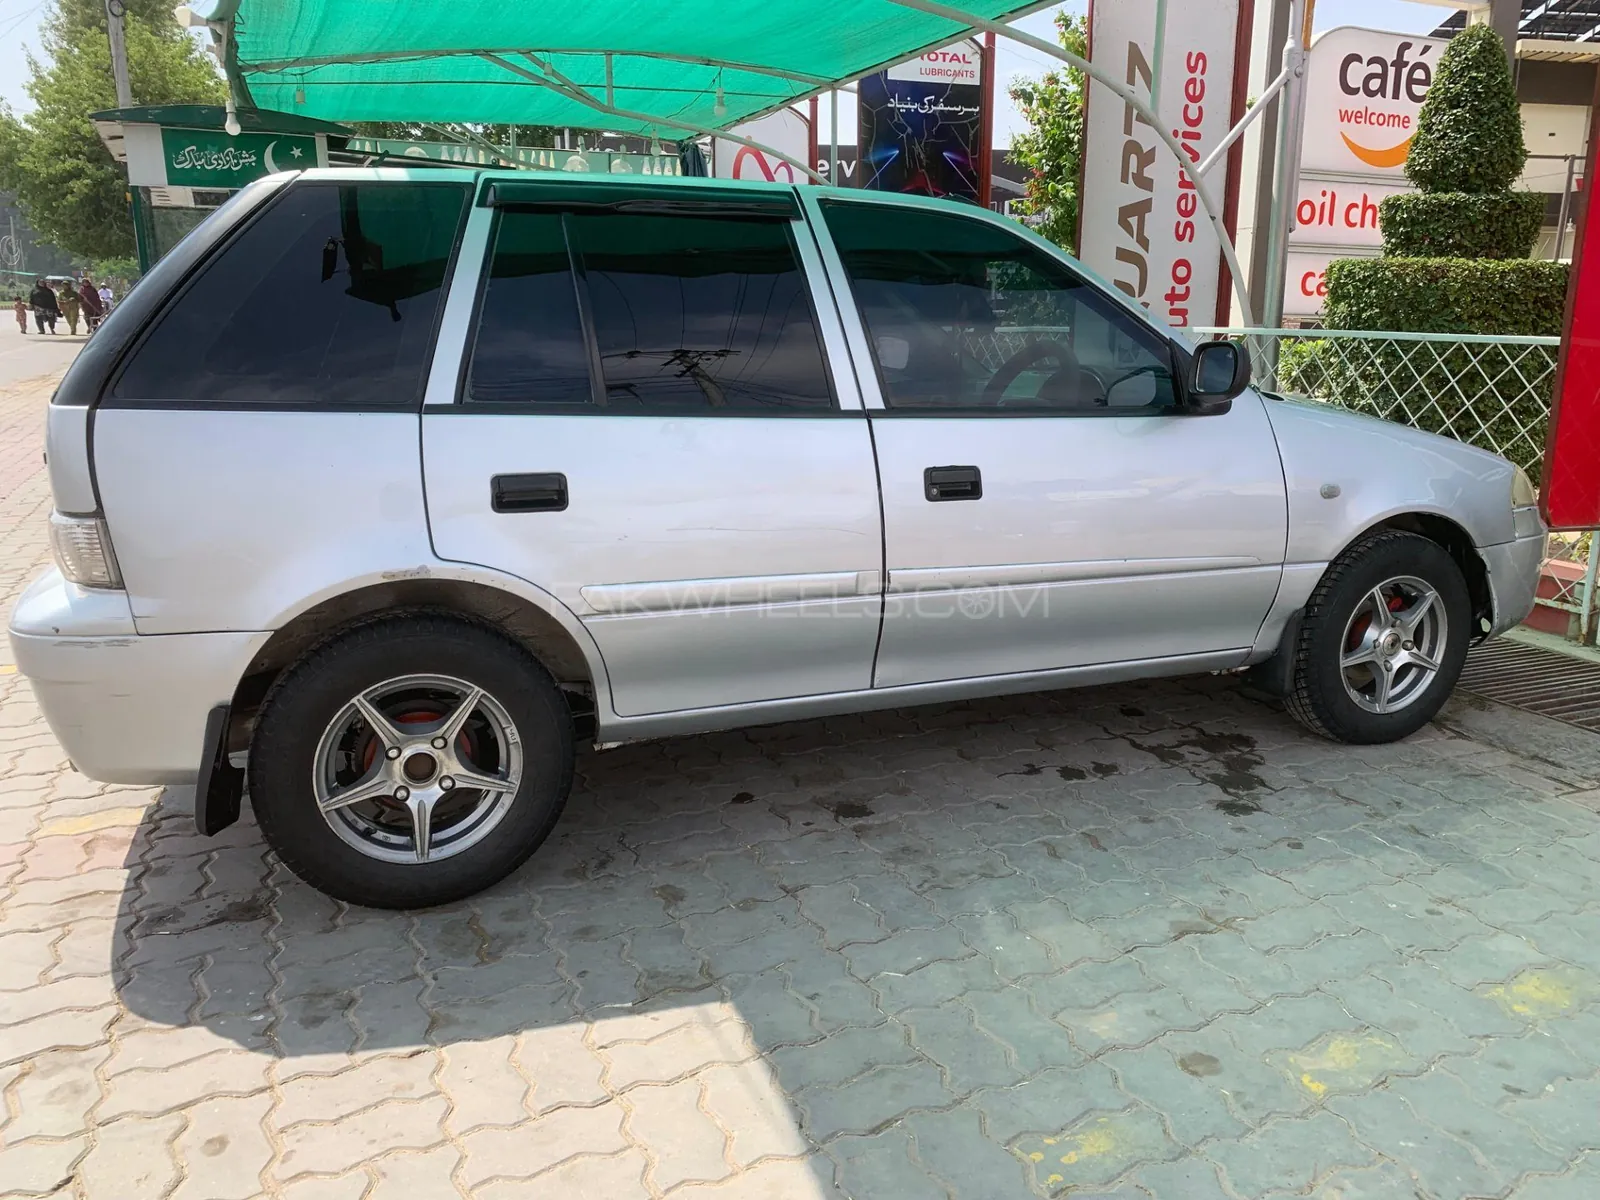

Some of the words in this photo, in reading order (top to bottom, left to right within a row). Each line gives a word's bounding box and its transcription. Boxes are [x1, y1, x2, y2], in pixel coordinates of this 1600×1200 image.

[920, 67, 975, 78] LUBRICANTS
[1339, 41, 1433, 104] café
[1172, 51, 1208, 243] services
[1338, 105, 1411, 129] welcome
[1113, 41, 1157, 309] UARTZ
[1296, 190, 1336, 227] oil
[1344, 193, 1378, 229] ch
[1164, 258, 1192, 328] uto
